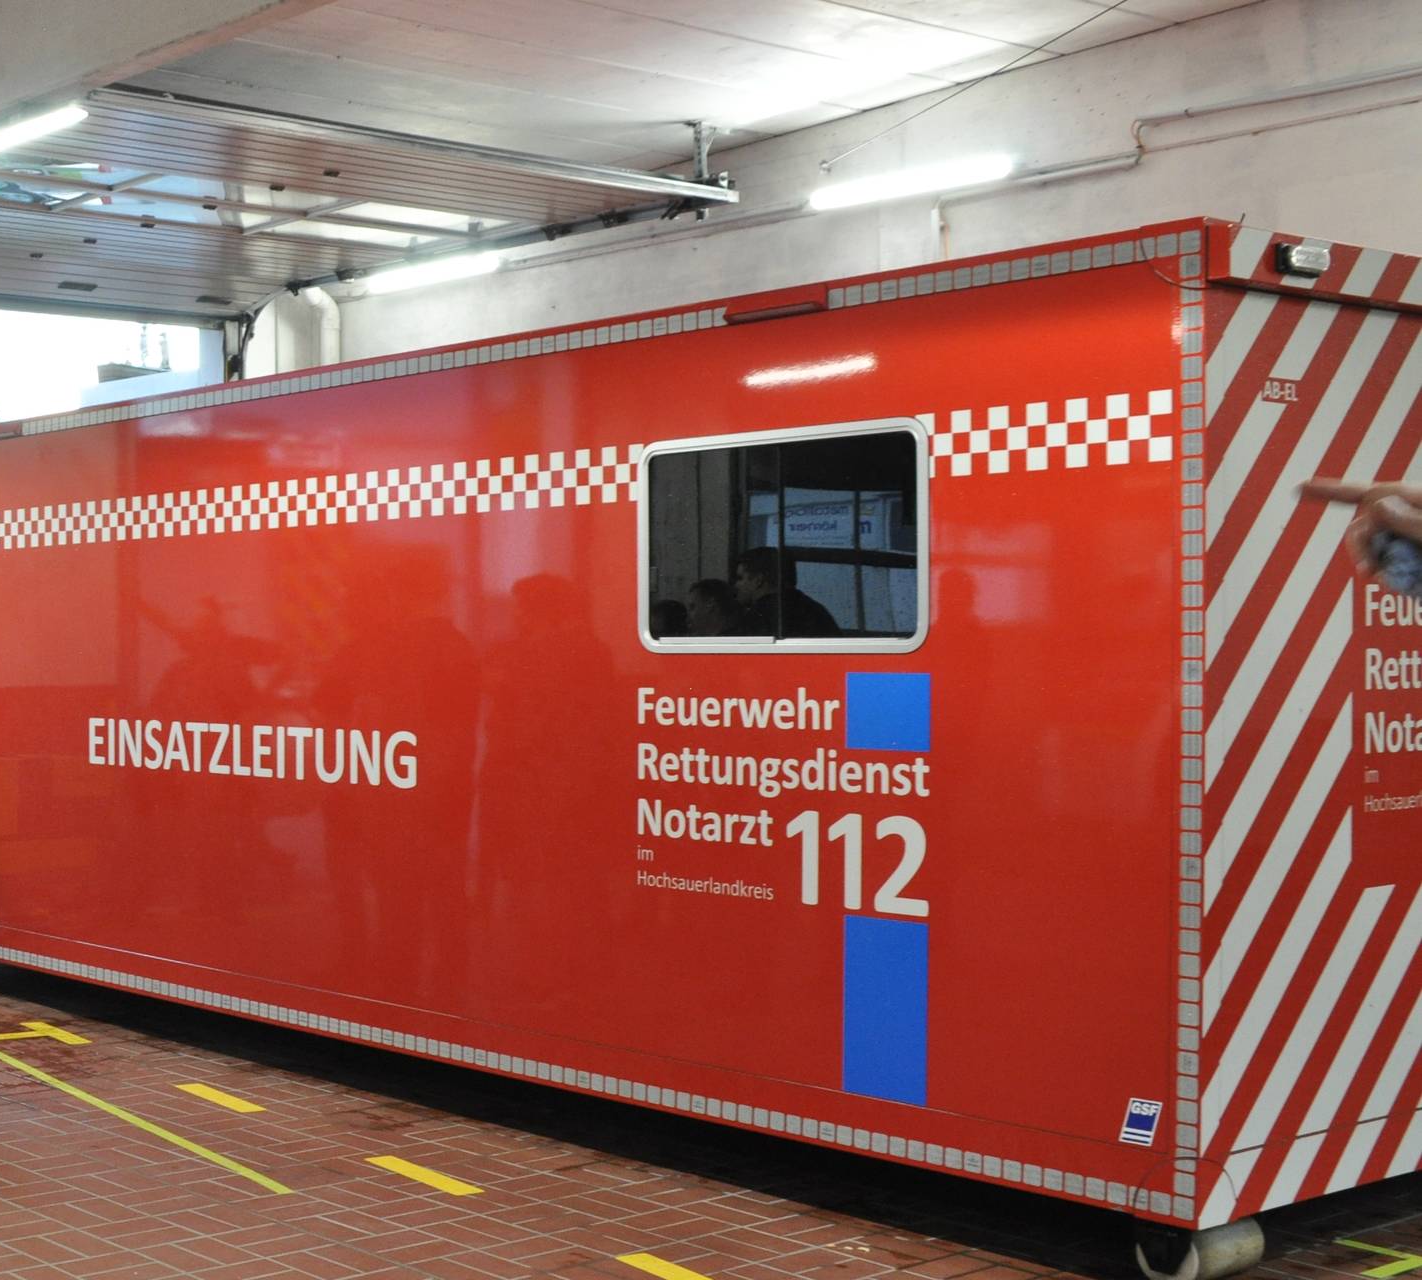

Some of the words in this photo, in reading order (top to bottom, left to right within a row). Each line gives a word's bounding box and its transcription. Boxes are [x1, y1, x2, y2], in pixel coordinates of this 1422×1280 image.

[1263, 380, 1298, 402] AB-EL
[1365, 648, 1422, 690] Rett
[638, 686, 840, 731] Feuerwehr
[88, 717, 417, 789] EINSATZLEITUNG
[638, 742, 930, 798] Rettungsdienst
[1365, 766, 1379, 784] im
[638, 798, 774, 846] Notarzt
[637, 845, 654, 861] im
[786, 810, 930, 917] 112
[637, 870, 774, 900] Hochsauerlandkreis
[1131, 1101, 1159, 1117] GSF
